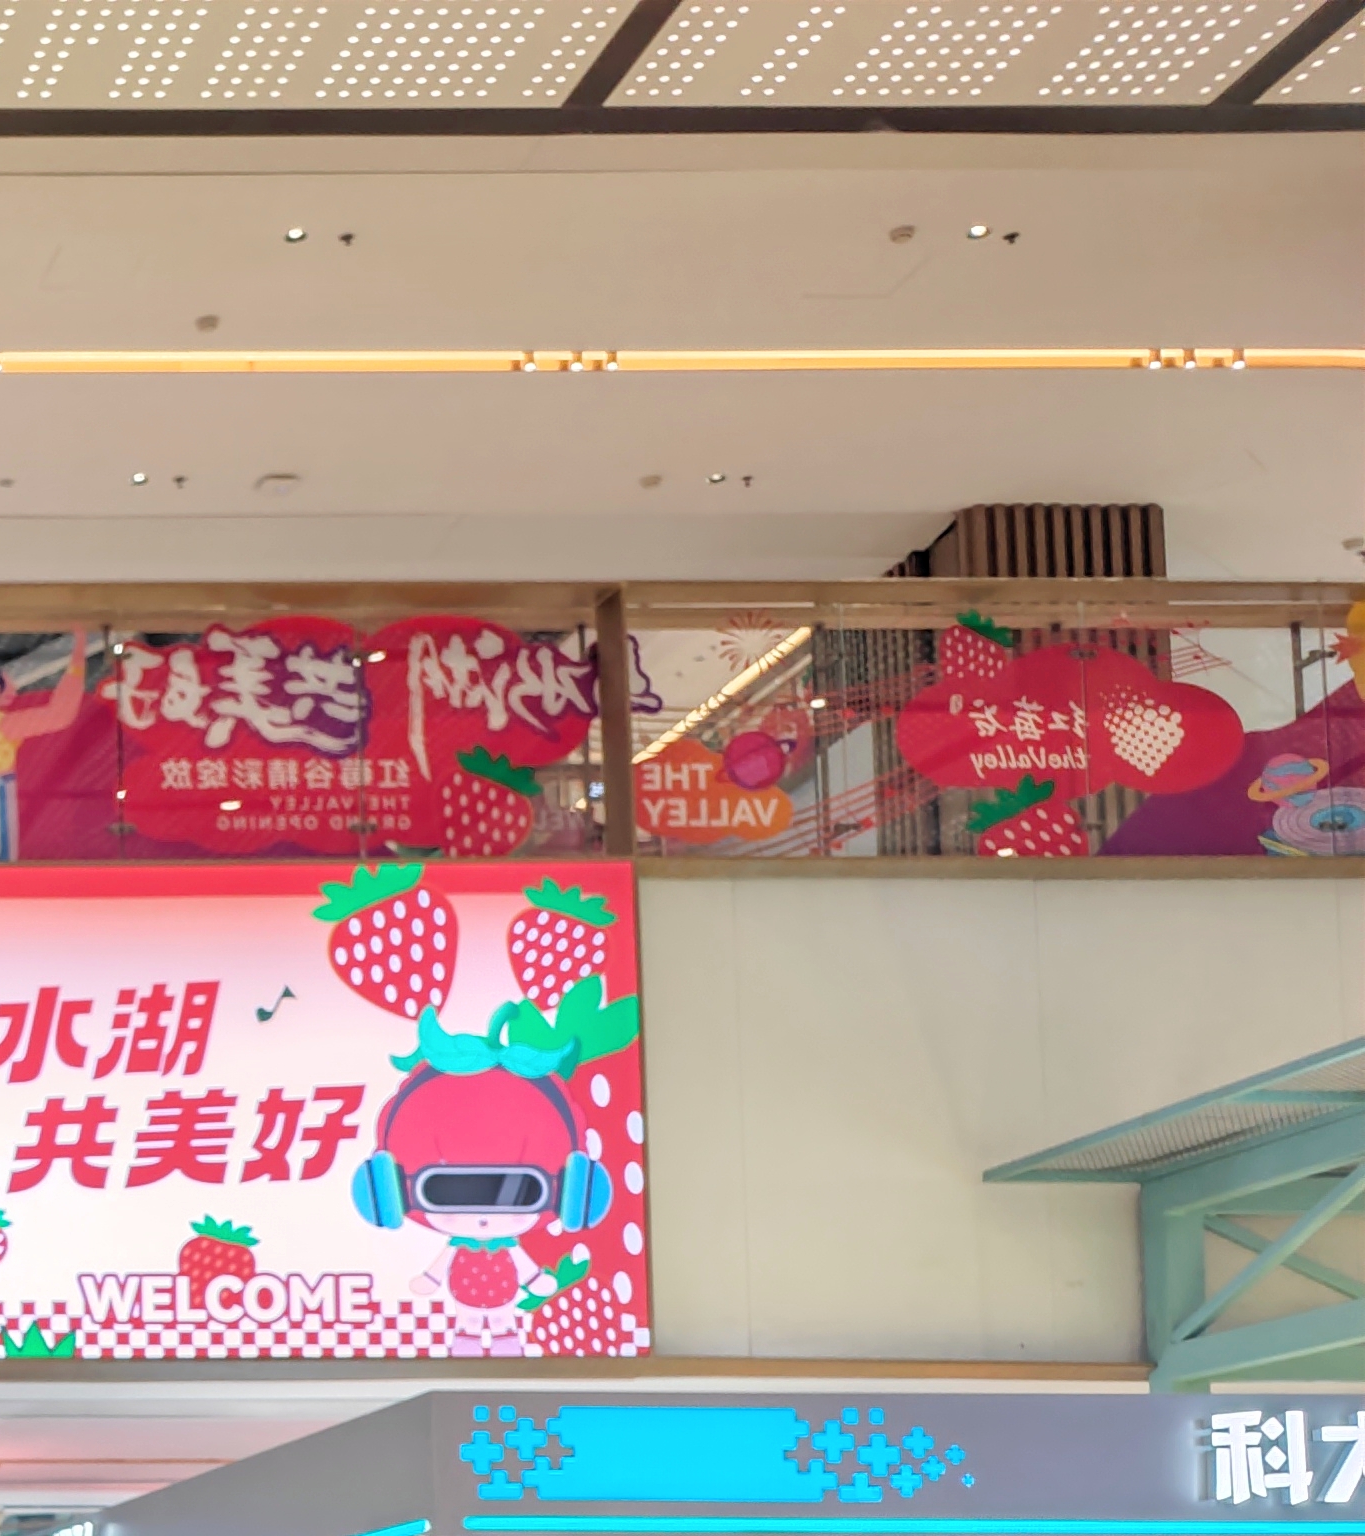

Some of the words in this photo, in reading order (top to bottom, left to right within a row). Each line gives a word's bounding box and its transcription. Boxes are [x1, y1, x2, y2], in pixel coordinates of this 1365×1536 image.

[6, 1084, 366, 1194] 共美好
[77, 1273, 373, 1324] WELCOME
